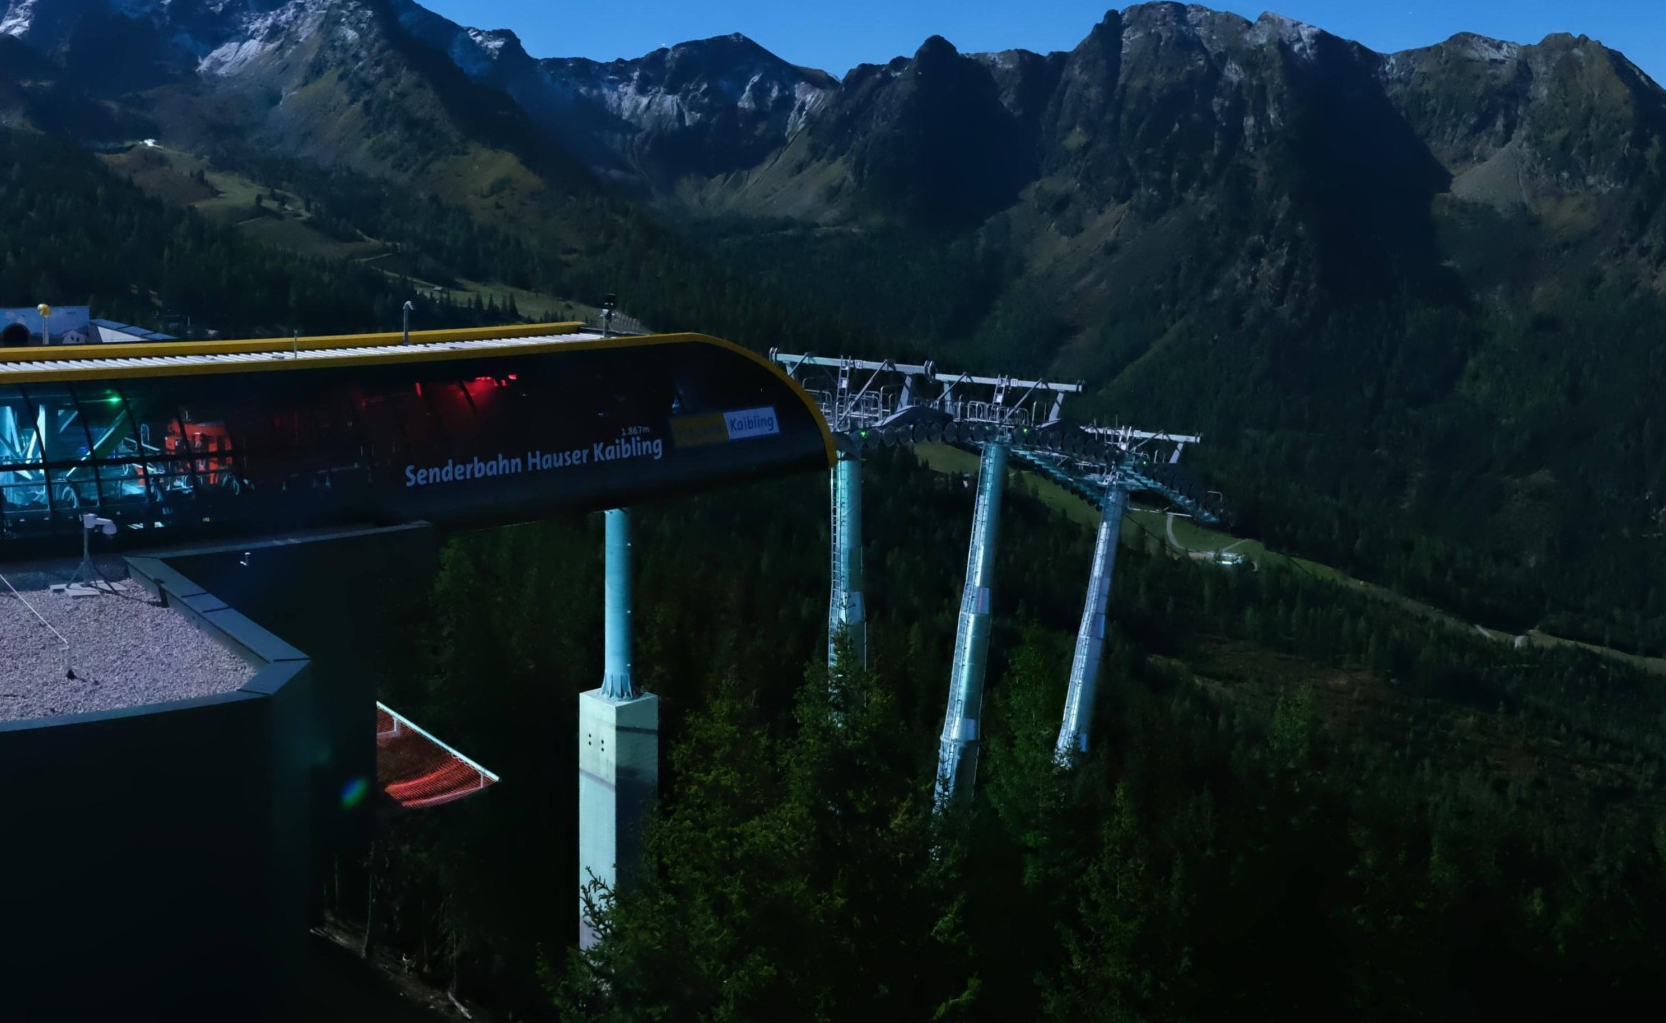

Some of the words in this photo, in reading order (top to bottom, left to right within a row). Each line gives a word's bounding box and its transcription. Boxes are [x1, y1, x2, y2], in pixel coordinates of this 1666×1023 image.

[730, 415, 774, 432] Kaibling
[405, 453, 522, 487] Senderbahn
[527, 448, 590, 472] Hauser
[594, 437, 663, 462] Kaibling
